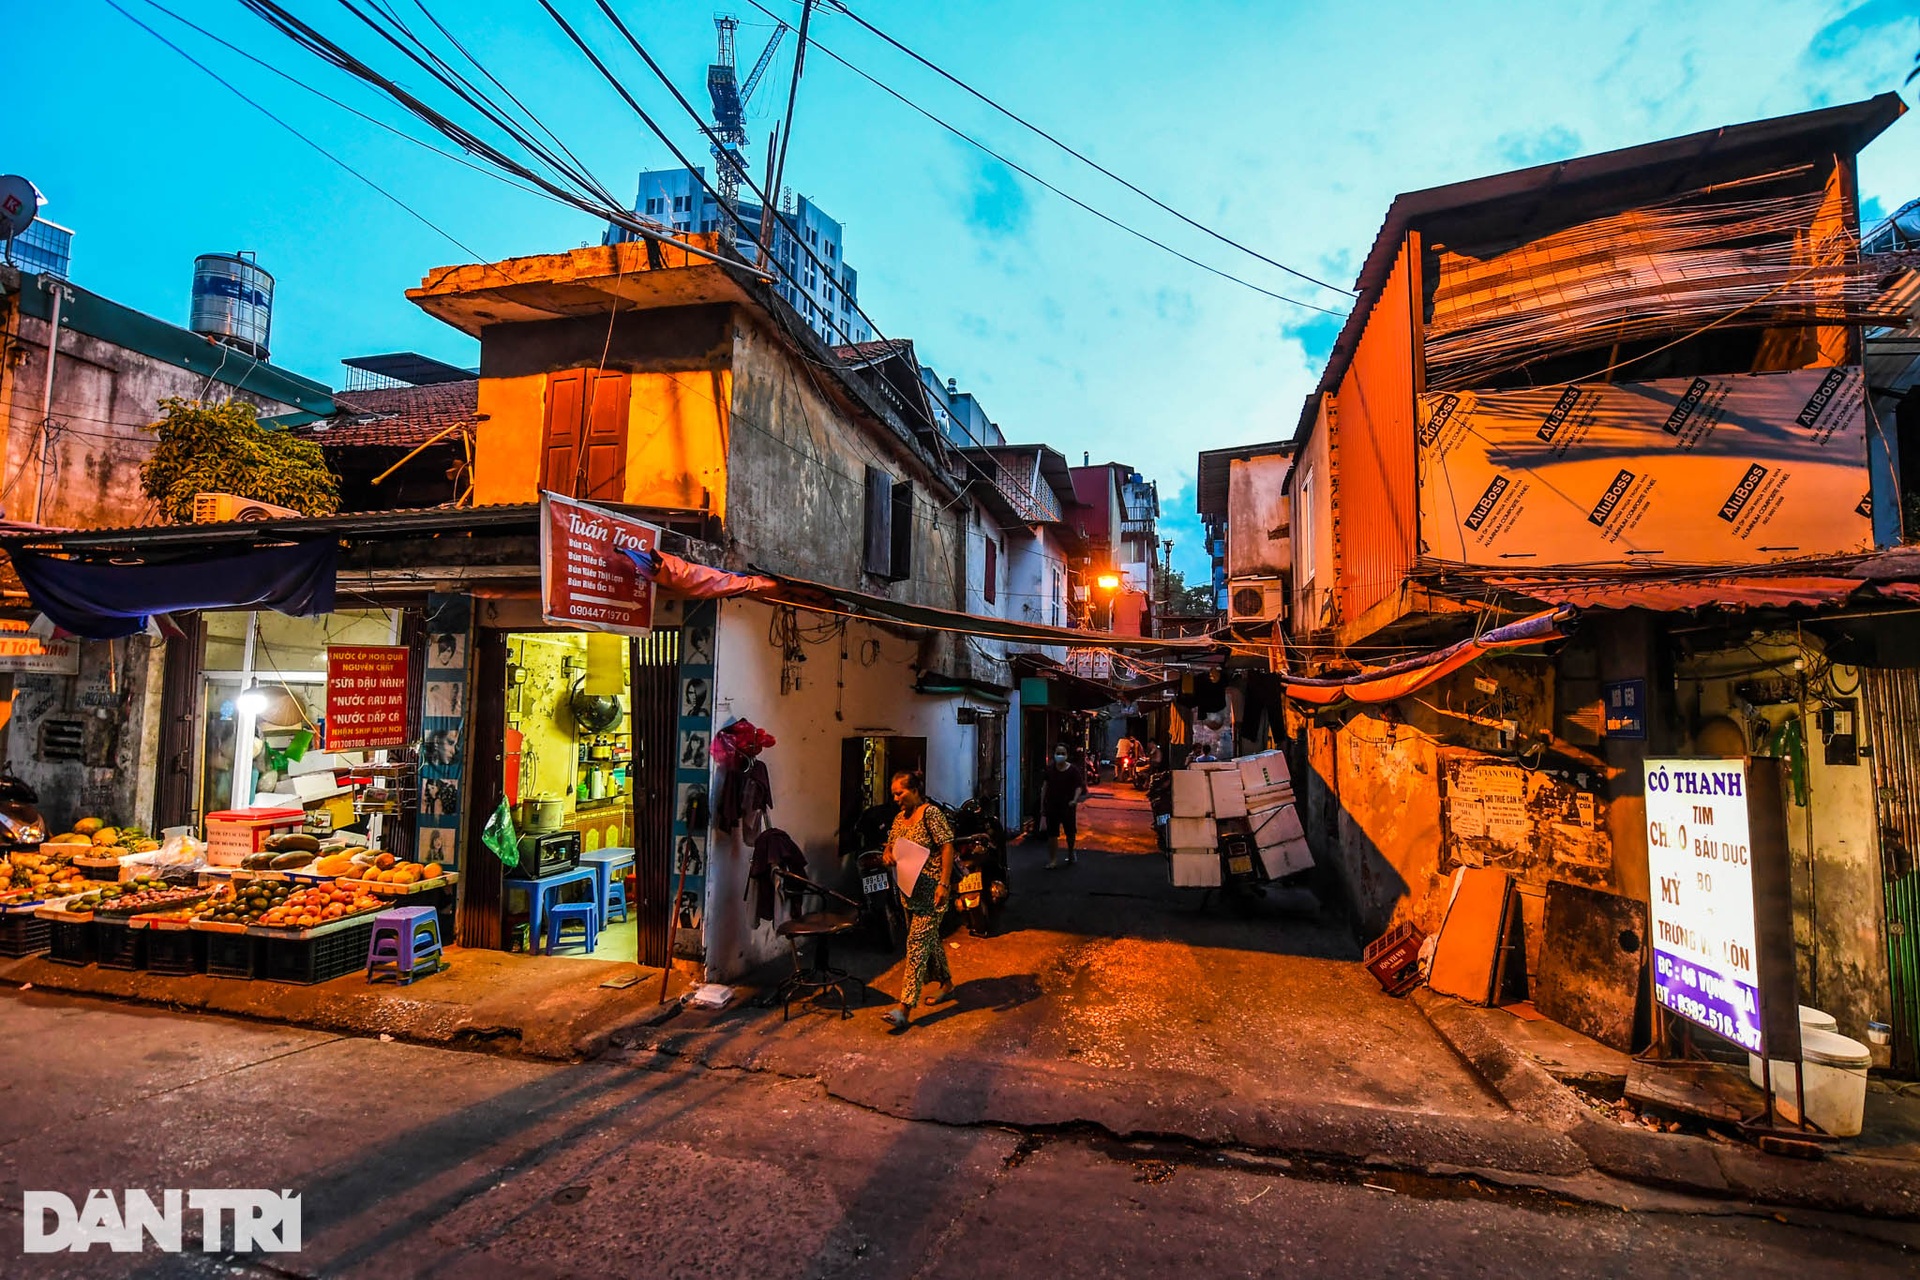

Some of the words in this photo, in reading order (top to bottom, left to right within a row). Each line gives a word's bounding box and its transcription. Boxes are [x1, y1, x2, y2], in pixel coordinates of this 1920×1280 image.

[1419, 395, 1459, 444] AluBoss
[1539, 387, 1578, 438] AluBoss
[1666, 379, 1707, 431] AluBoss
[1799, 370, 1843, 425] AluBoss
[1466, 476, 1507, 527] AluBoss
[1483, 522, 1503, 547] ALUMINUM
[1499, 498, 1520, 524] COMPOSITE
[1517, 483, 1530, 499] PANEL
[1591, 471, 1632, 522] AluBoss
[1608, 518, 1629, 543] ALUMINUM
[1625, 493, 1645, 519] COMPOSITE
[1643, 478, 1656, 494] PANEL
[1721, 465, 1764, 518] AluBoss
[1740, 513, 1761, 540] ALUMINUM
[1758, 487, 1779, 514] COMPOSITE
[1776, 472, 1790, 488] PANEL
[569, 513, 608, 541] Tuấn
[569, 605, 630, 621] 0904471970
[1648, 764, 1669, 792] CÔ
[1673, 772, 1743, 797] THANH
[1650, 820, 1687, 850] CHO
[1692, 805, 1714, 826] TIM
[1722, 842, 1748, 869] DỤC
